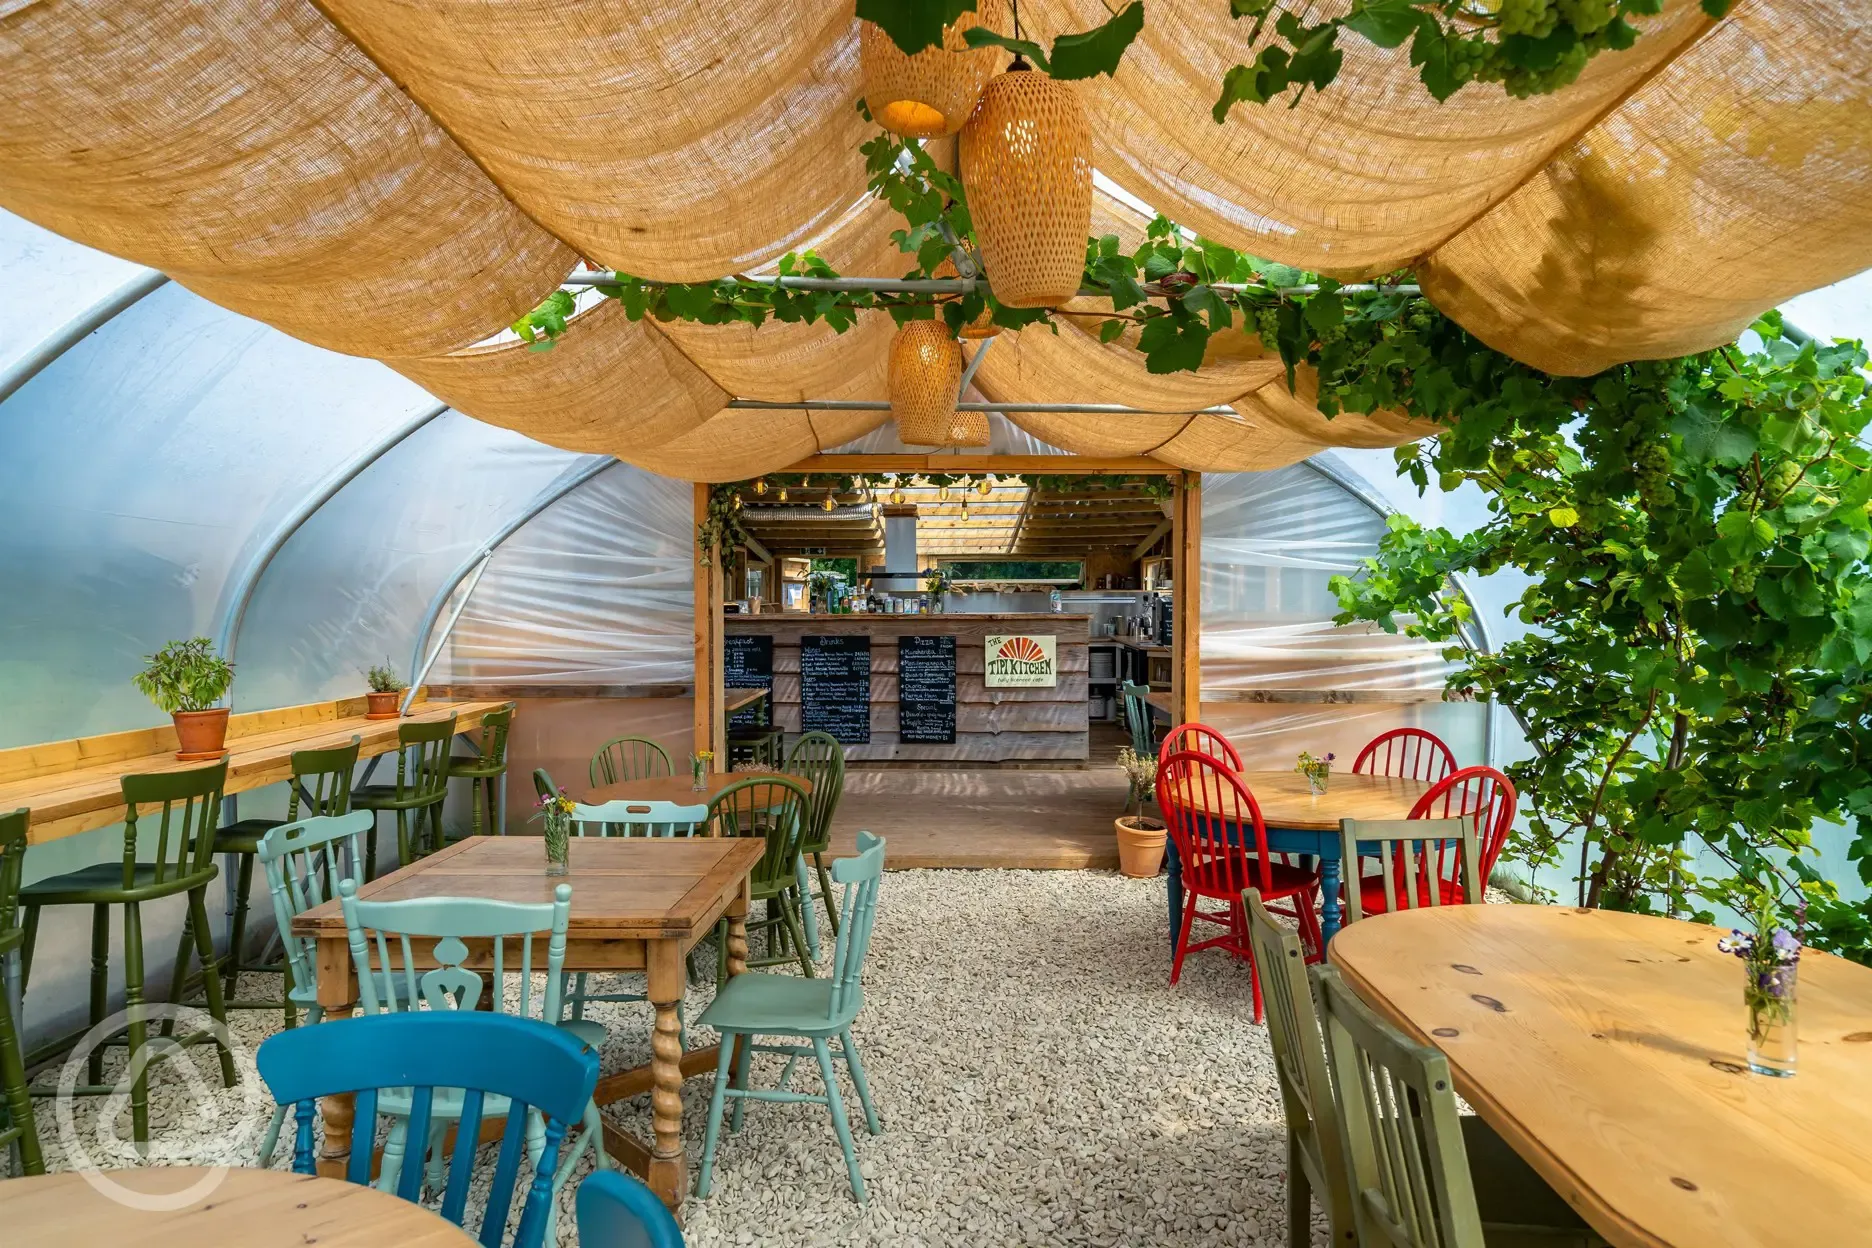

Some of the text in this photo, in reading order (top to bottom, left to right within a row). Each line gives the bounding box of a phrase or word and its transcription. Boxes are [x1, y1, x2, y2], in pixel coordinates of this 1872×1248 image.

[820, 636, 844, 646] Drinks
[914, 637, 935, 646] Pizza
[988, 637, 1002, 647] THE
[988, 658, 1052, 675] TIPI KITCHEN
